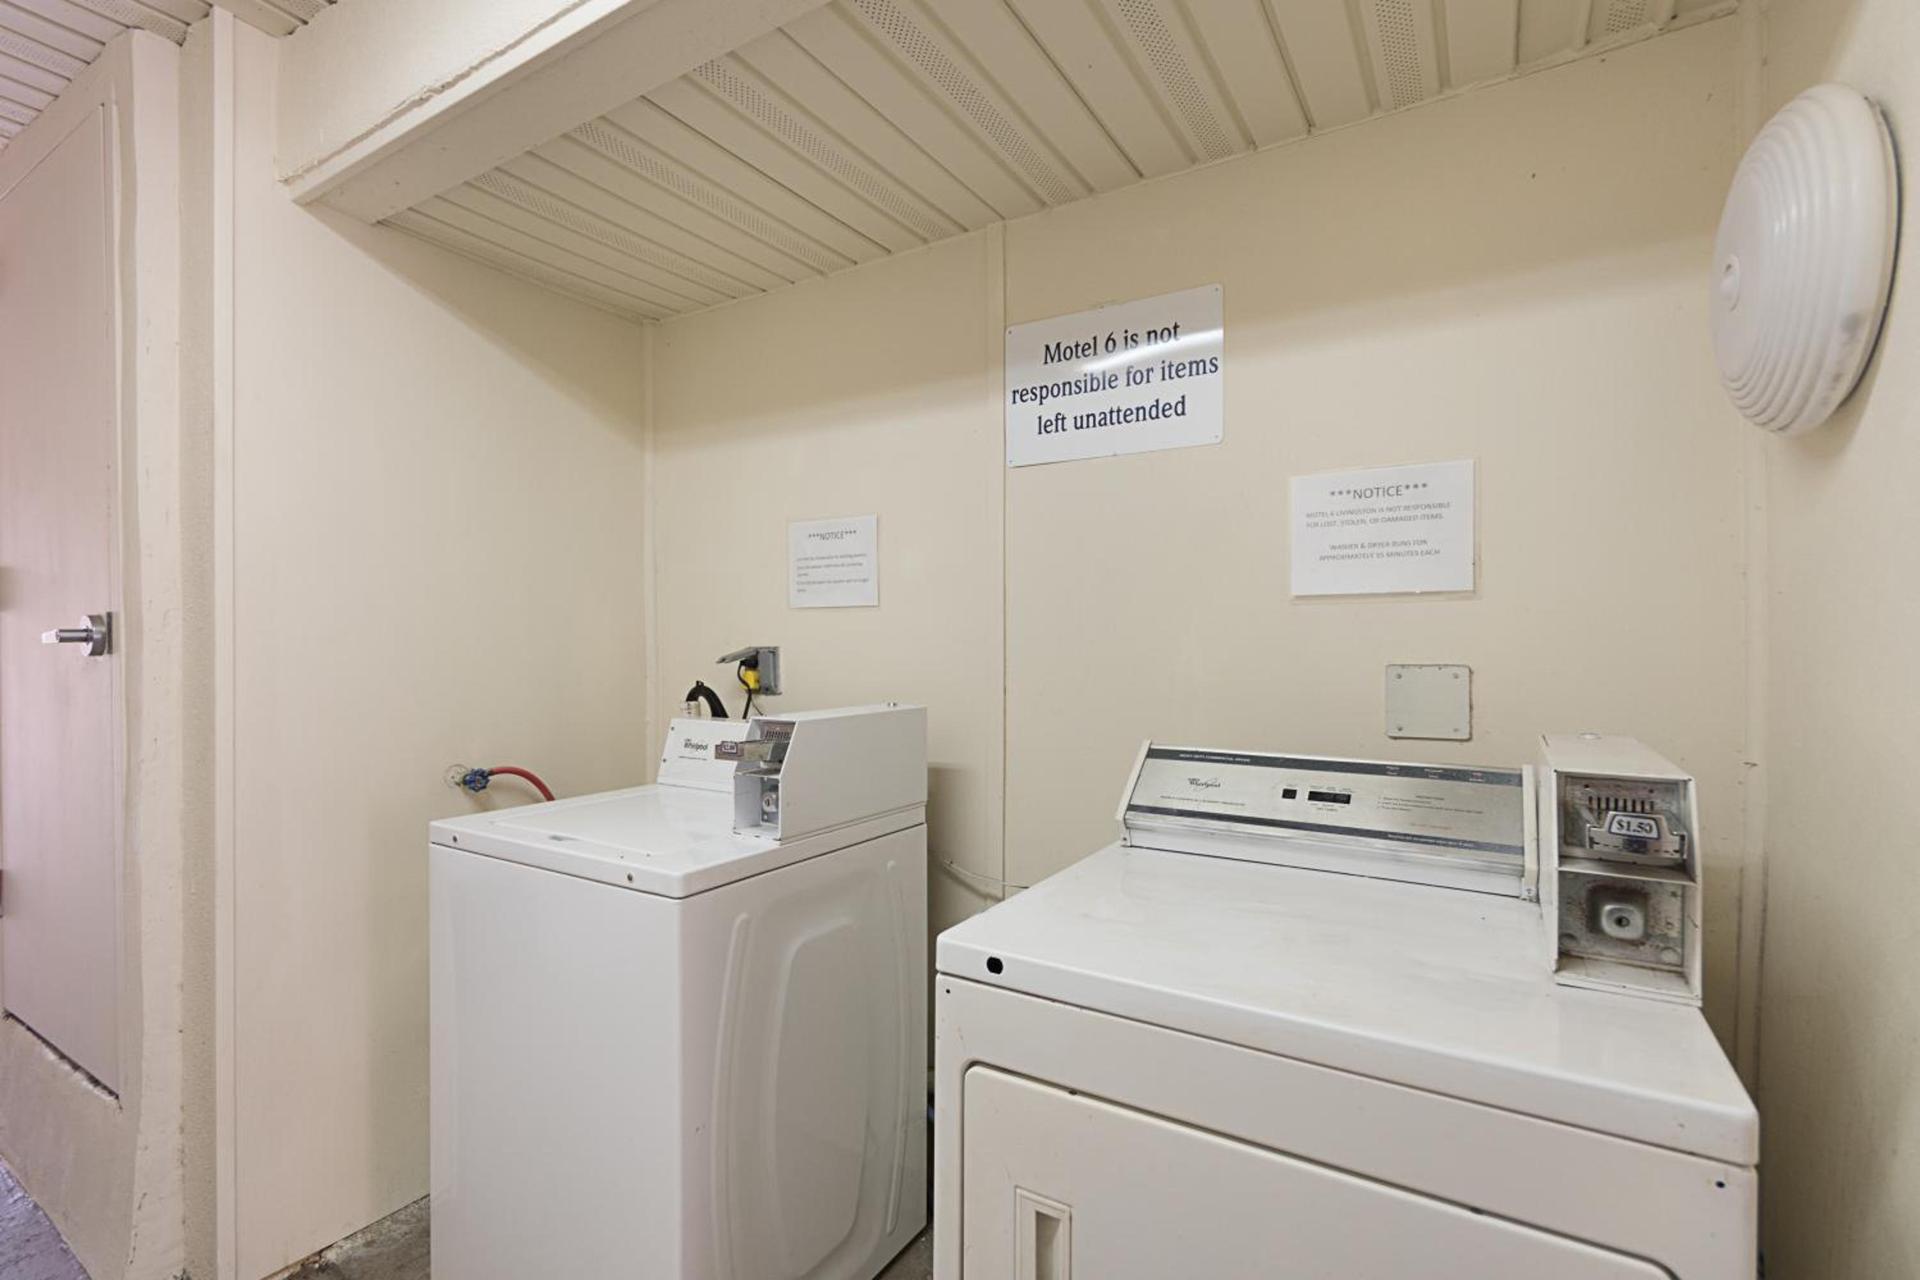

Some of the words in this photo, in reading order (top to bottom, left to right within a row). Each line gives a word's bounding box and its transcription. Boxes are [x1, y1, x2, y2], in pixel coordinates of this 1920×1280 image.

[1043, 336, 1098, 365] Motel
[1105, 333, 1116, 353] 6
[1123, 329, 1138, 349] is
[1147, 321, 1181, 343] not
[1011, 369, 1118, 406] responsible
[1126, 364, 1154, 387] for
[1161, 356, 1219, 382] items
[1037, 412, 1067, 435] left
[1074, 395, 1186, 431] unattended
[1386, 505, 1401, 513] NOT
[1616, 818, 1654, 834] $1.50
